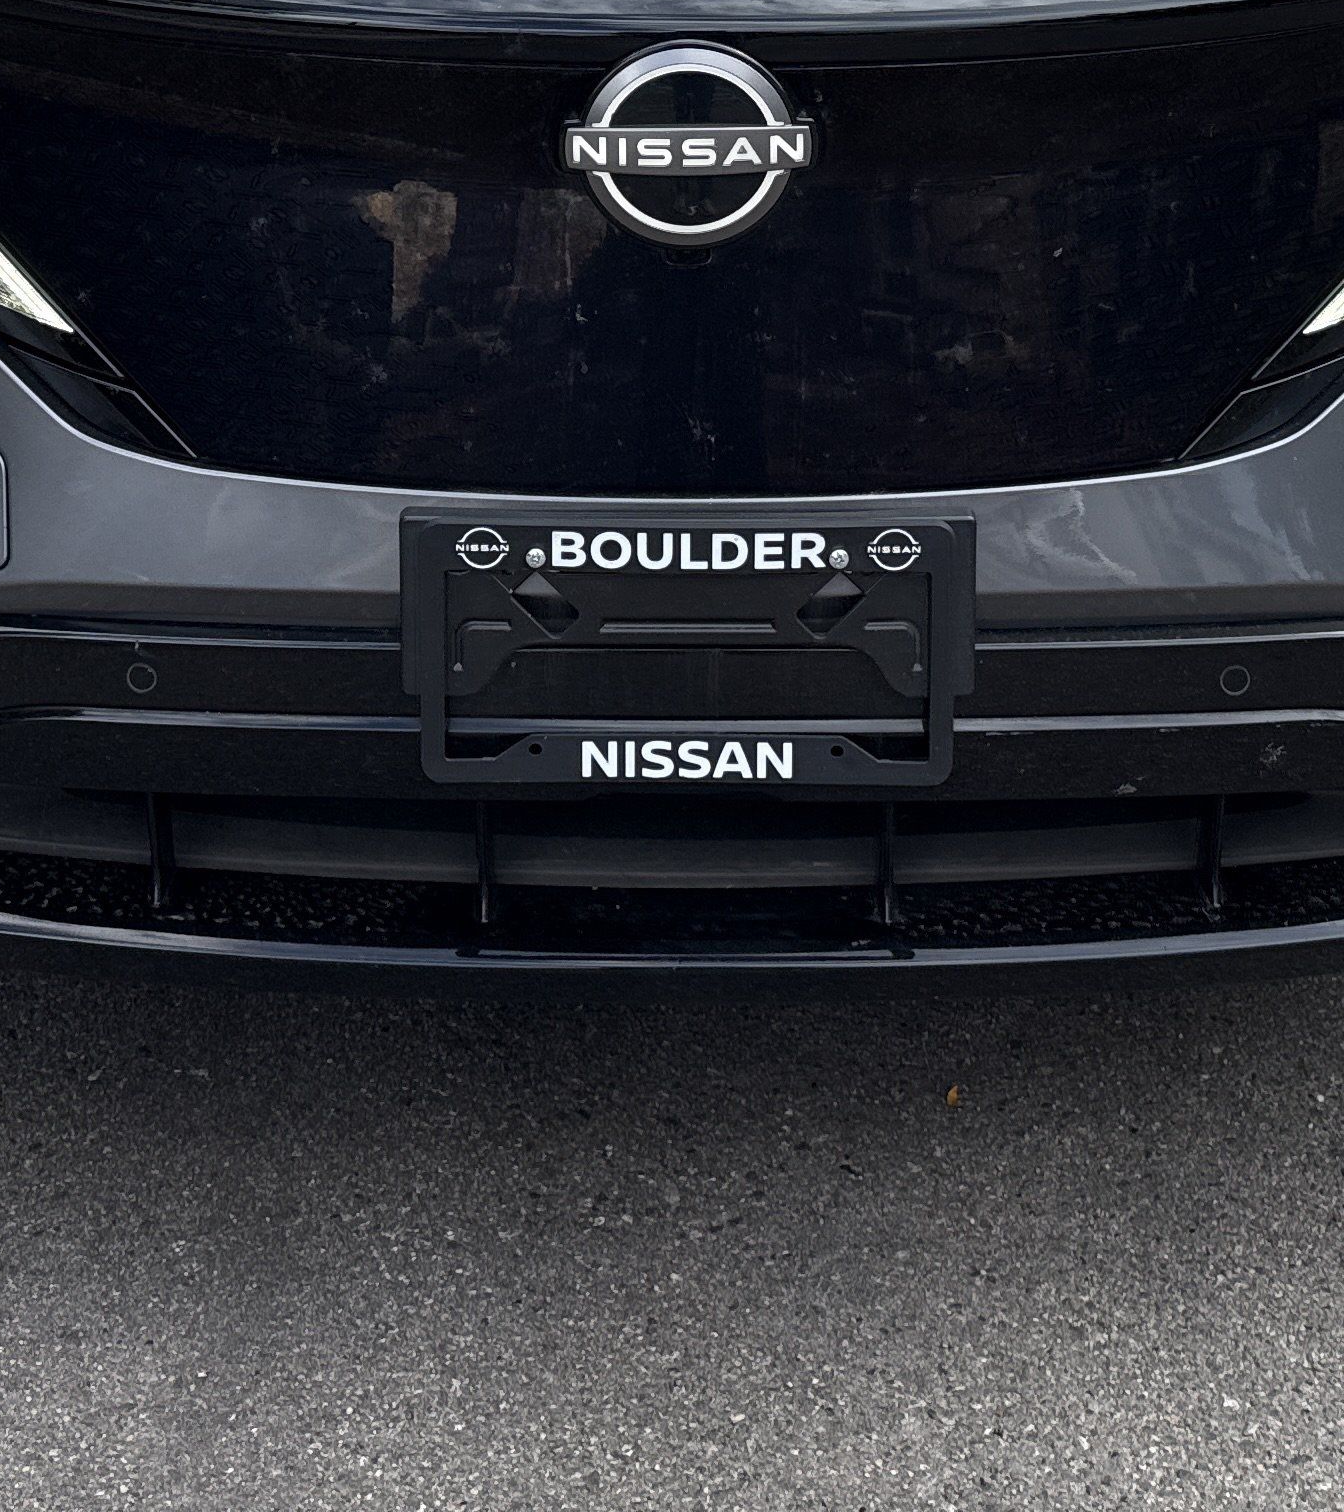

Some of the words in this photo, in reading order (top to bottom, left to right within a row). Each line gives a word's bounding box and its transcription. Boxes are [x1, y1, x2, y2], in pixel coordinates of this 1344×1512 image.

[571, 133, 805, 168] NISSAN
[455, 543, 509, 552] NISSAN
[551, 530, 827, 570] BOULDER
[867, 545, 921, 554] NISSAN
[581, 740, 793, 779] NISSAN
